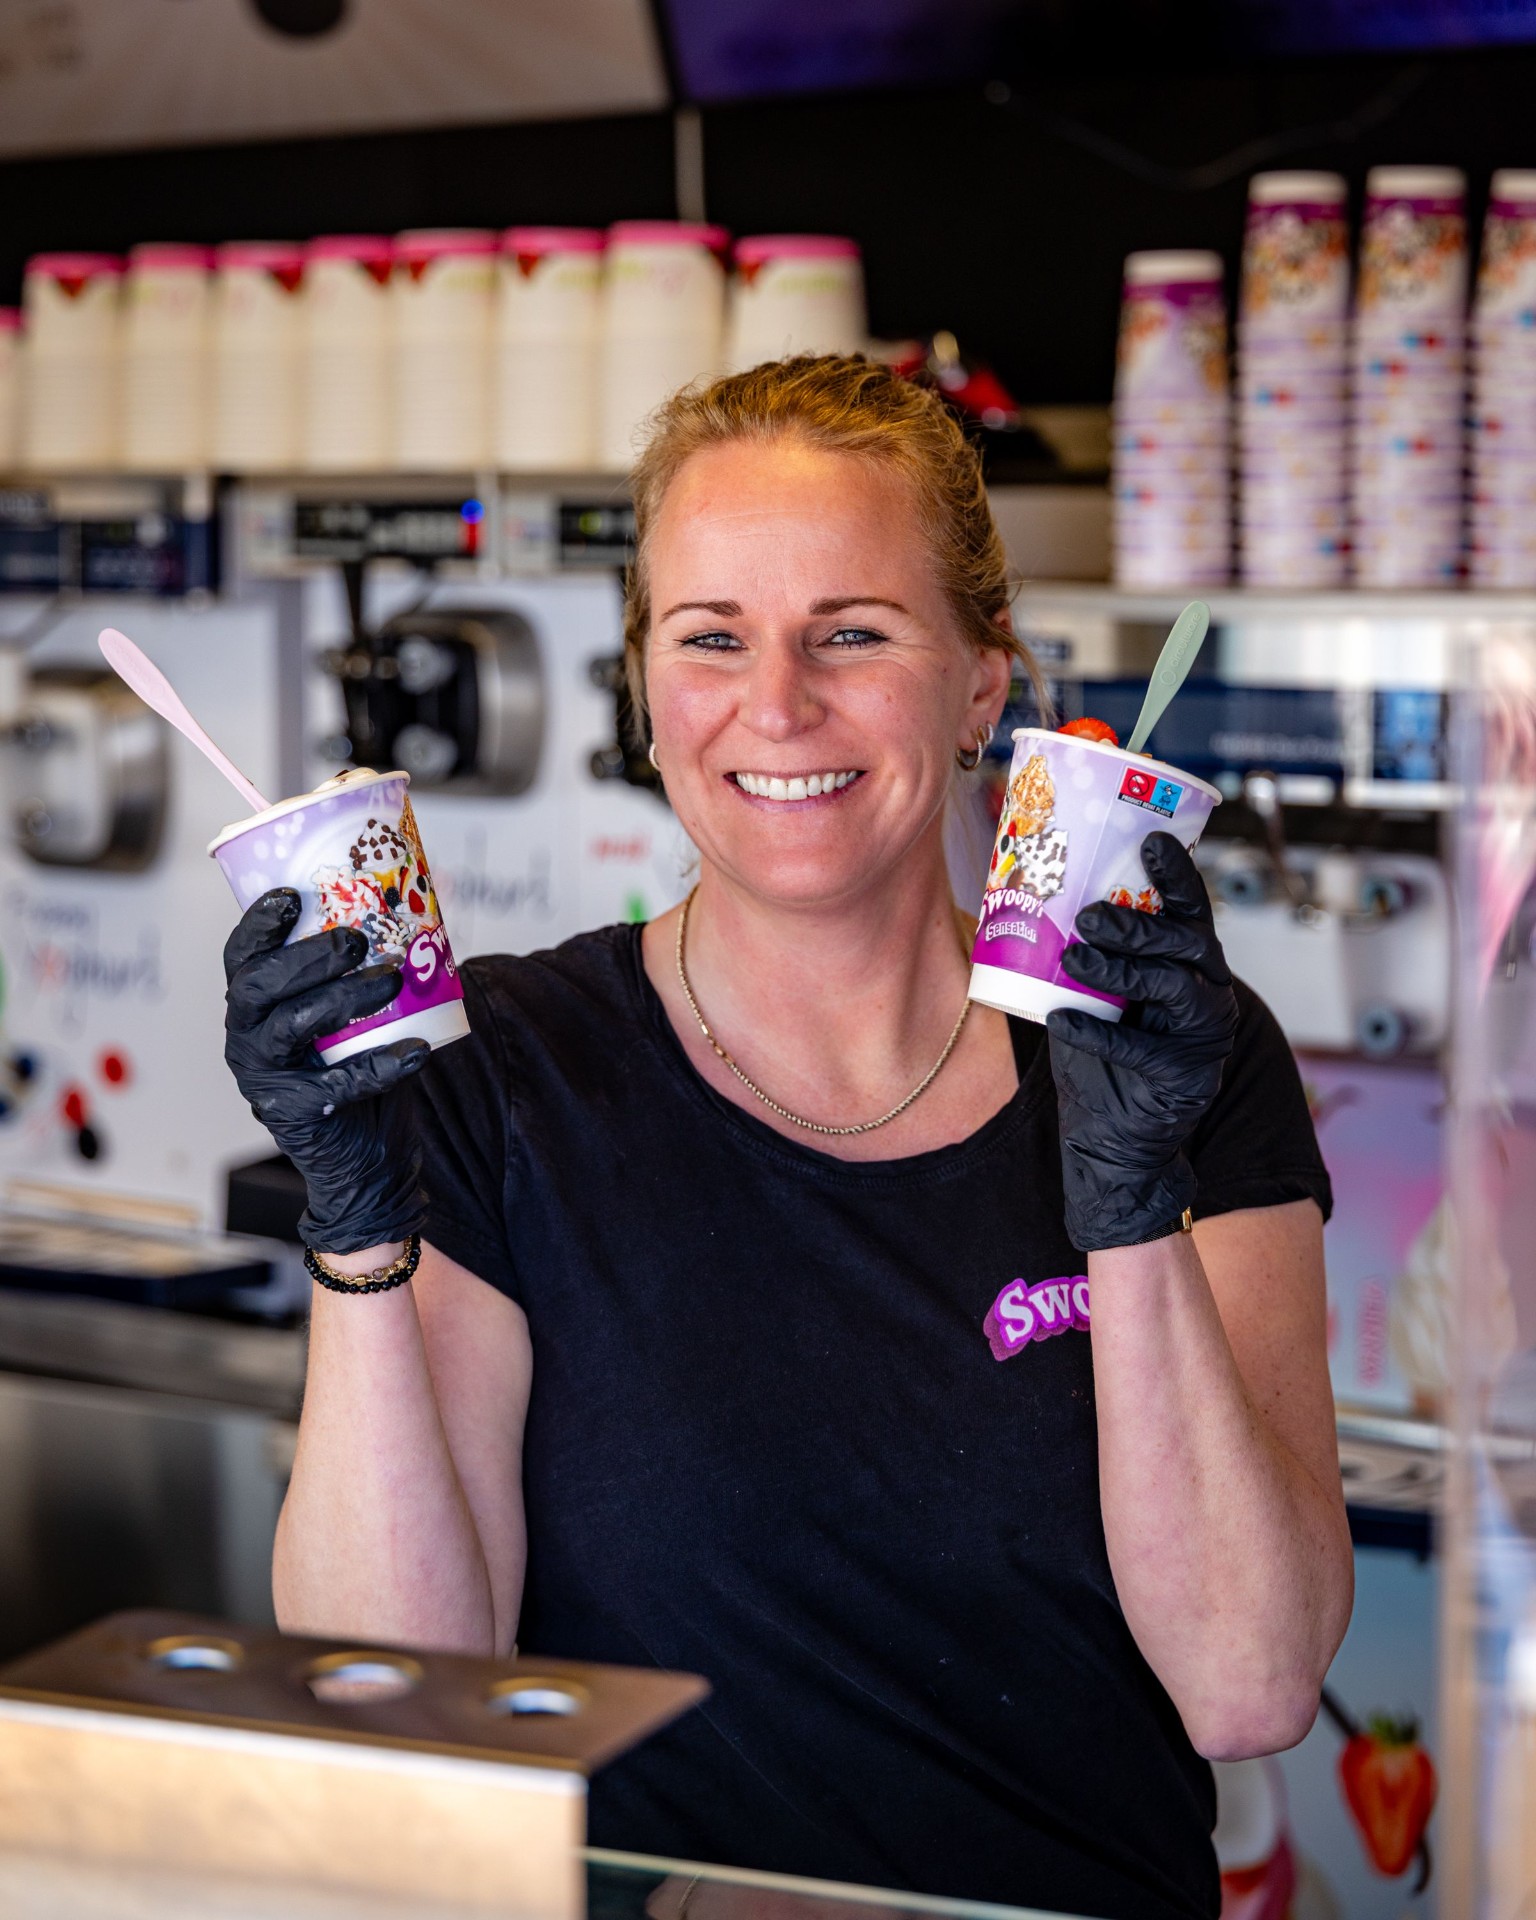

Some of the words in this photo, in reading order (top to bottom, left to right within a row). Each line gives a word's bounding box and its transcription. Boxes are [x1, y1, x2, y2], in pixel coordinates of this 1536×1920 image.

[1121, 794, 1143, 807] PRODUCT
[1156, 806, 1171, 817] PLASTIC
[986, 921, 1037, 942] Sensation
